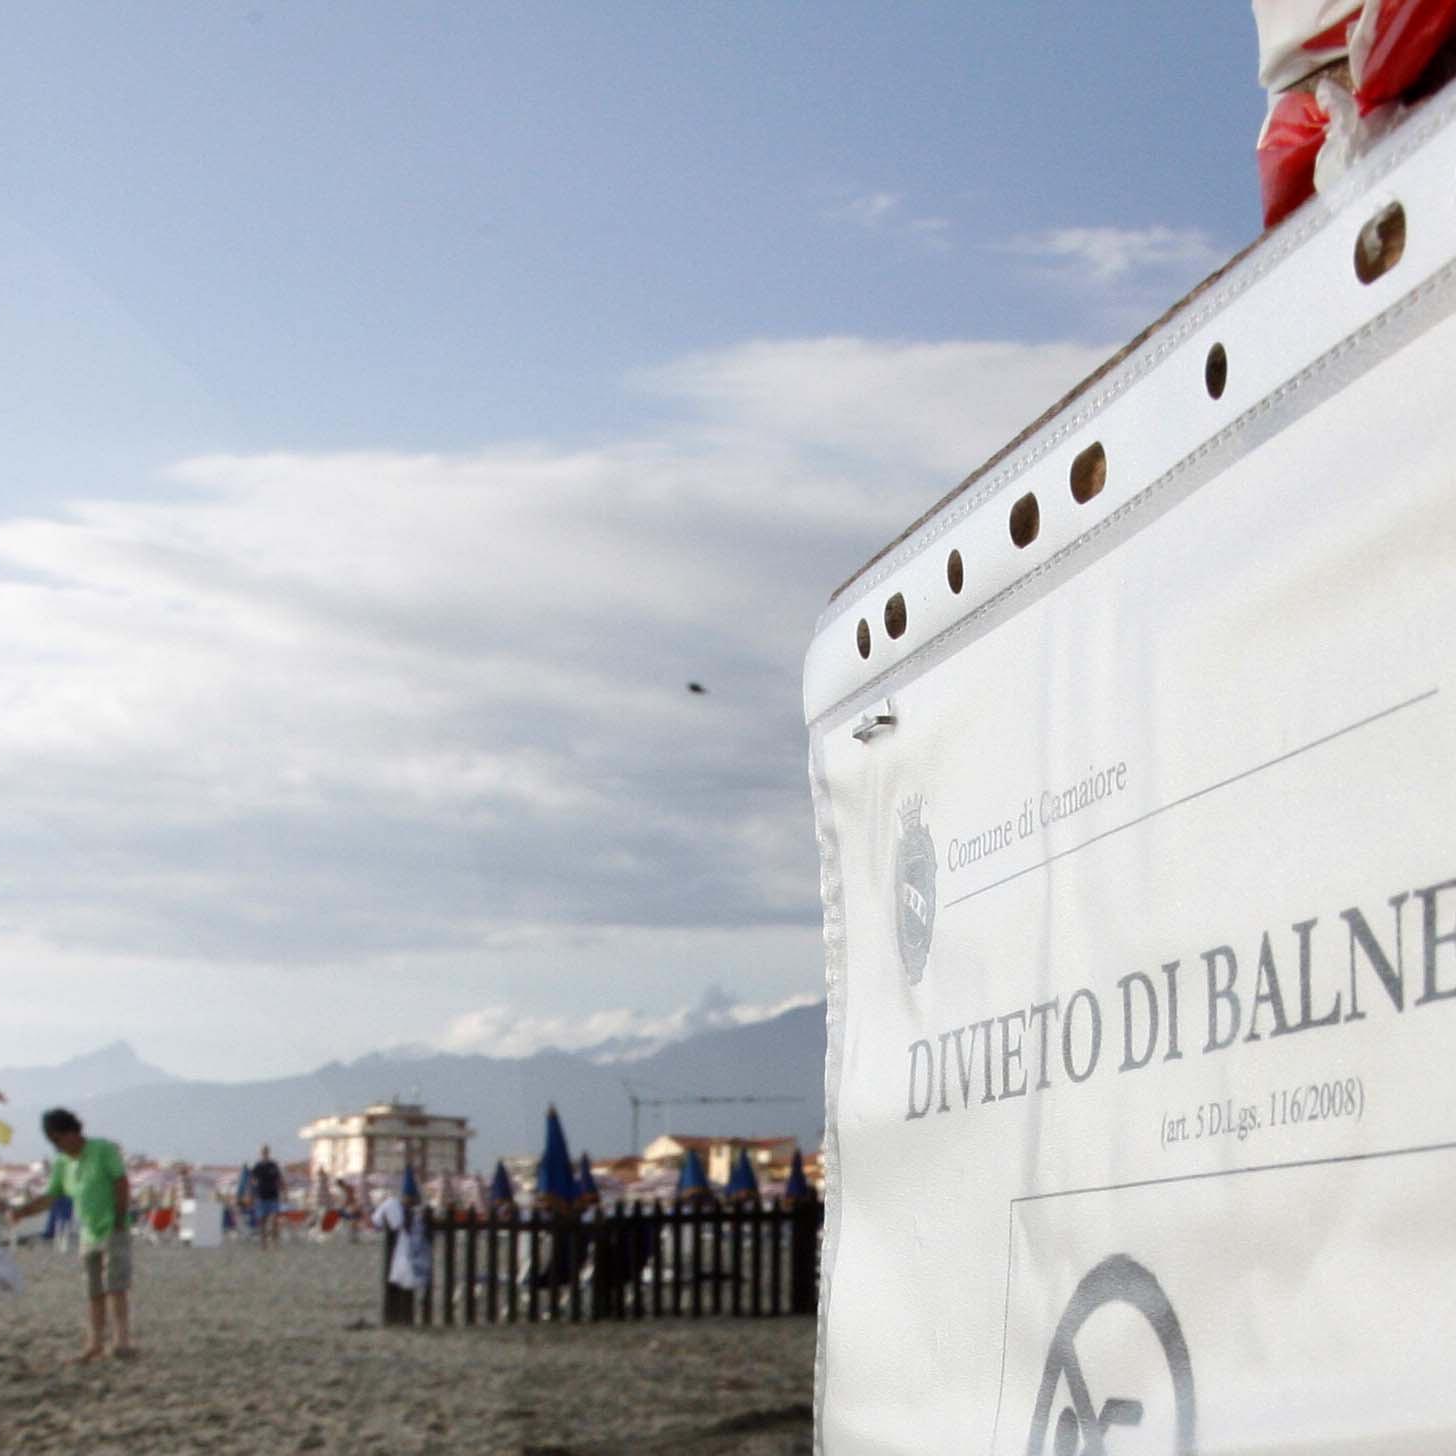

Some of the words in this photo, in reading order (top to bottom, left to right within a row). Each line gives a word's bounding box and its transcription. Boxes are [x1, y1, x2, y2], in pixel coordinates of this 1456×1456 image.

[947, 820, 1013, 872] Comune
[1017, 797, 1034, 839] di
[1039, 761, 1128, 828] Camaiore
[905, 988, 1103, 1121] DIVIETO
[1117, 960, 1183, 1073] DI
[1160, 1111, 1190, 1151] (art.
[1195, 1105, 1205, 1139] 5
[1268, 1076, 1366, 1127] 116/2008)
